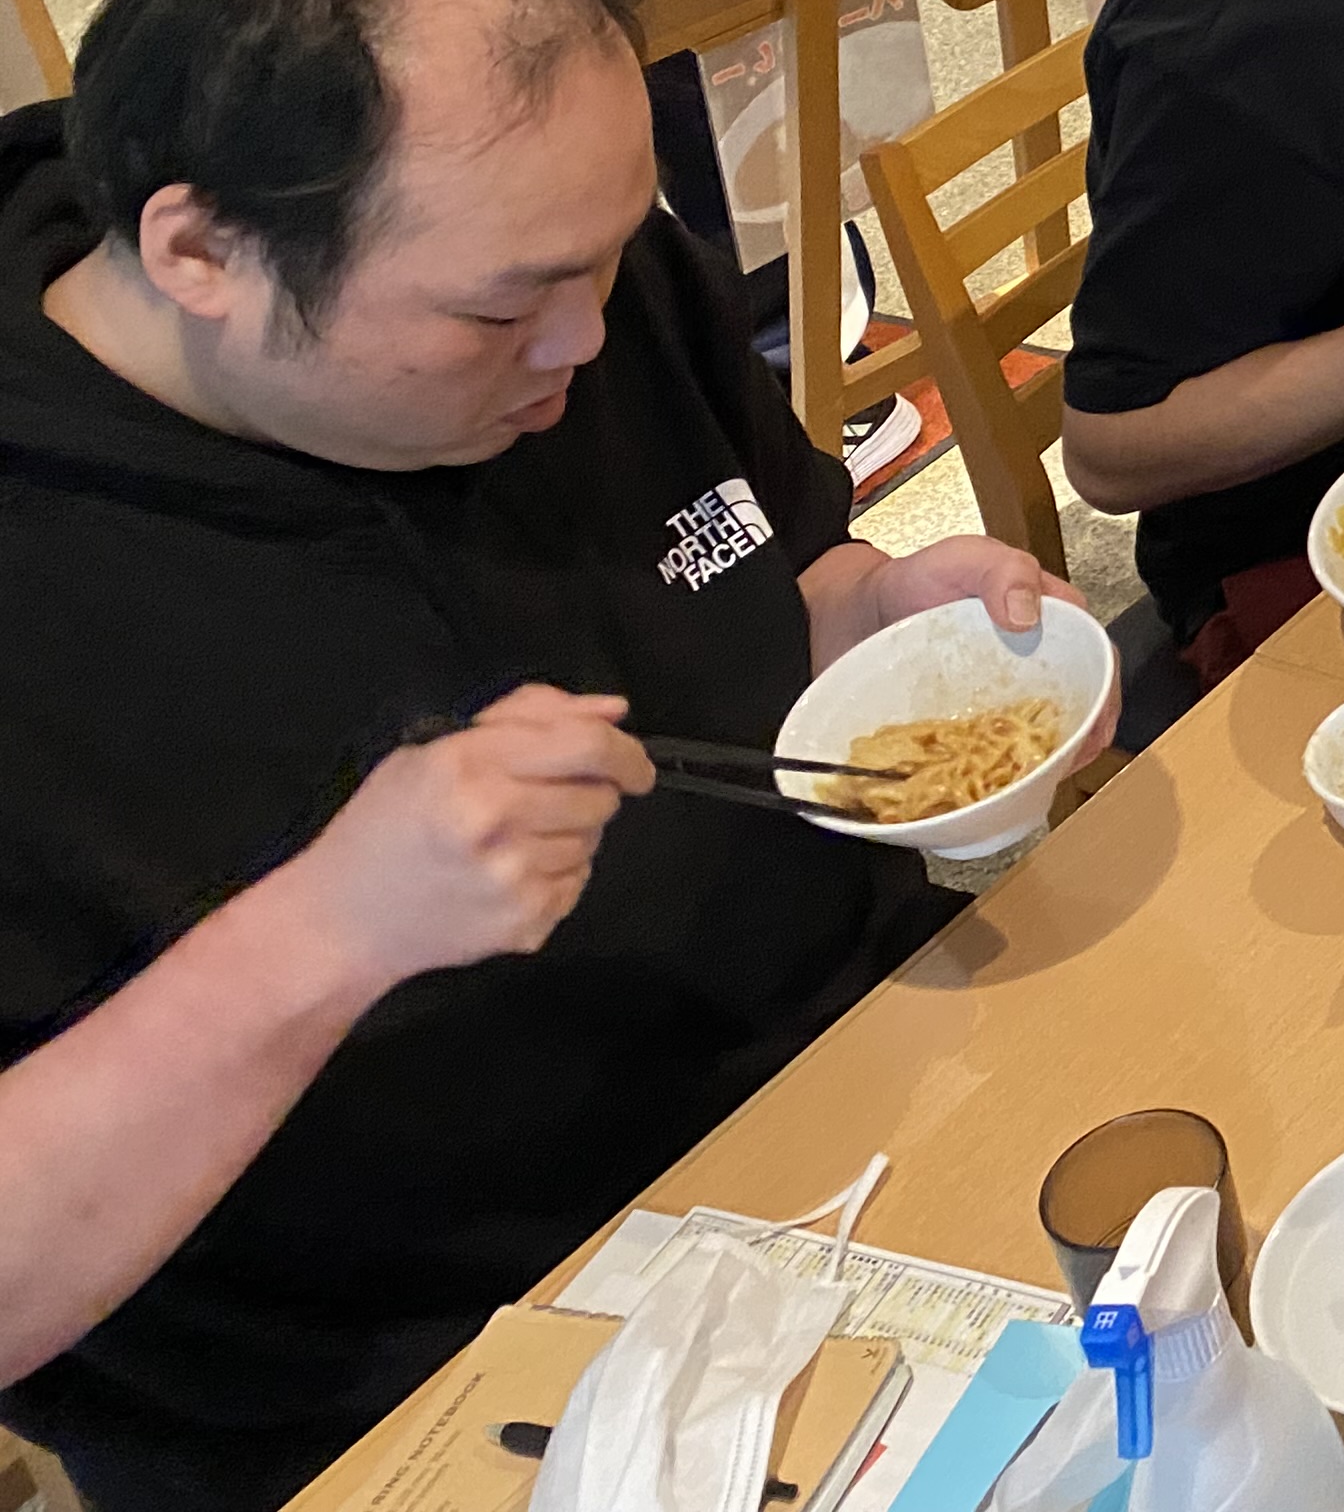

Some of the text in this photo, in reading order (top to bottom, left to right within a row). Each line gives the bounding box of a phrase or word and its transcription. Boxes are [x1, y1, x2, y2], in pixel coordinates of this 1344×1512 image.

[656, 510, 741, 585] NORTH
[665, 490, 727, 538] THE
[683, 530, 756, 592] FACE
[371, 1466, 411, 1506] RING
[408, 1372, 487, 1461] NOTEBOOK
